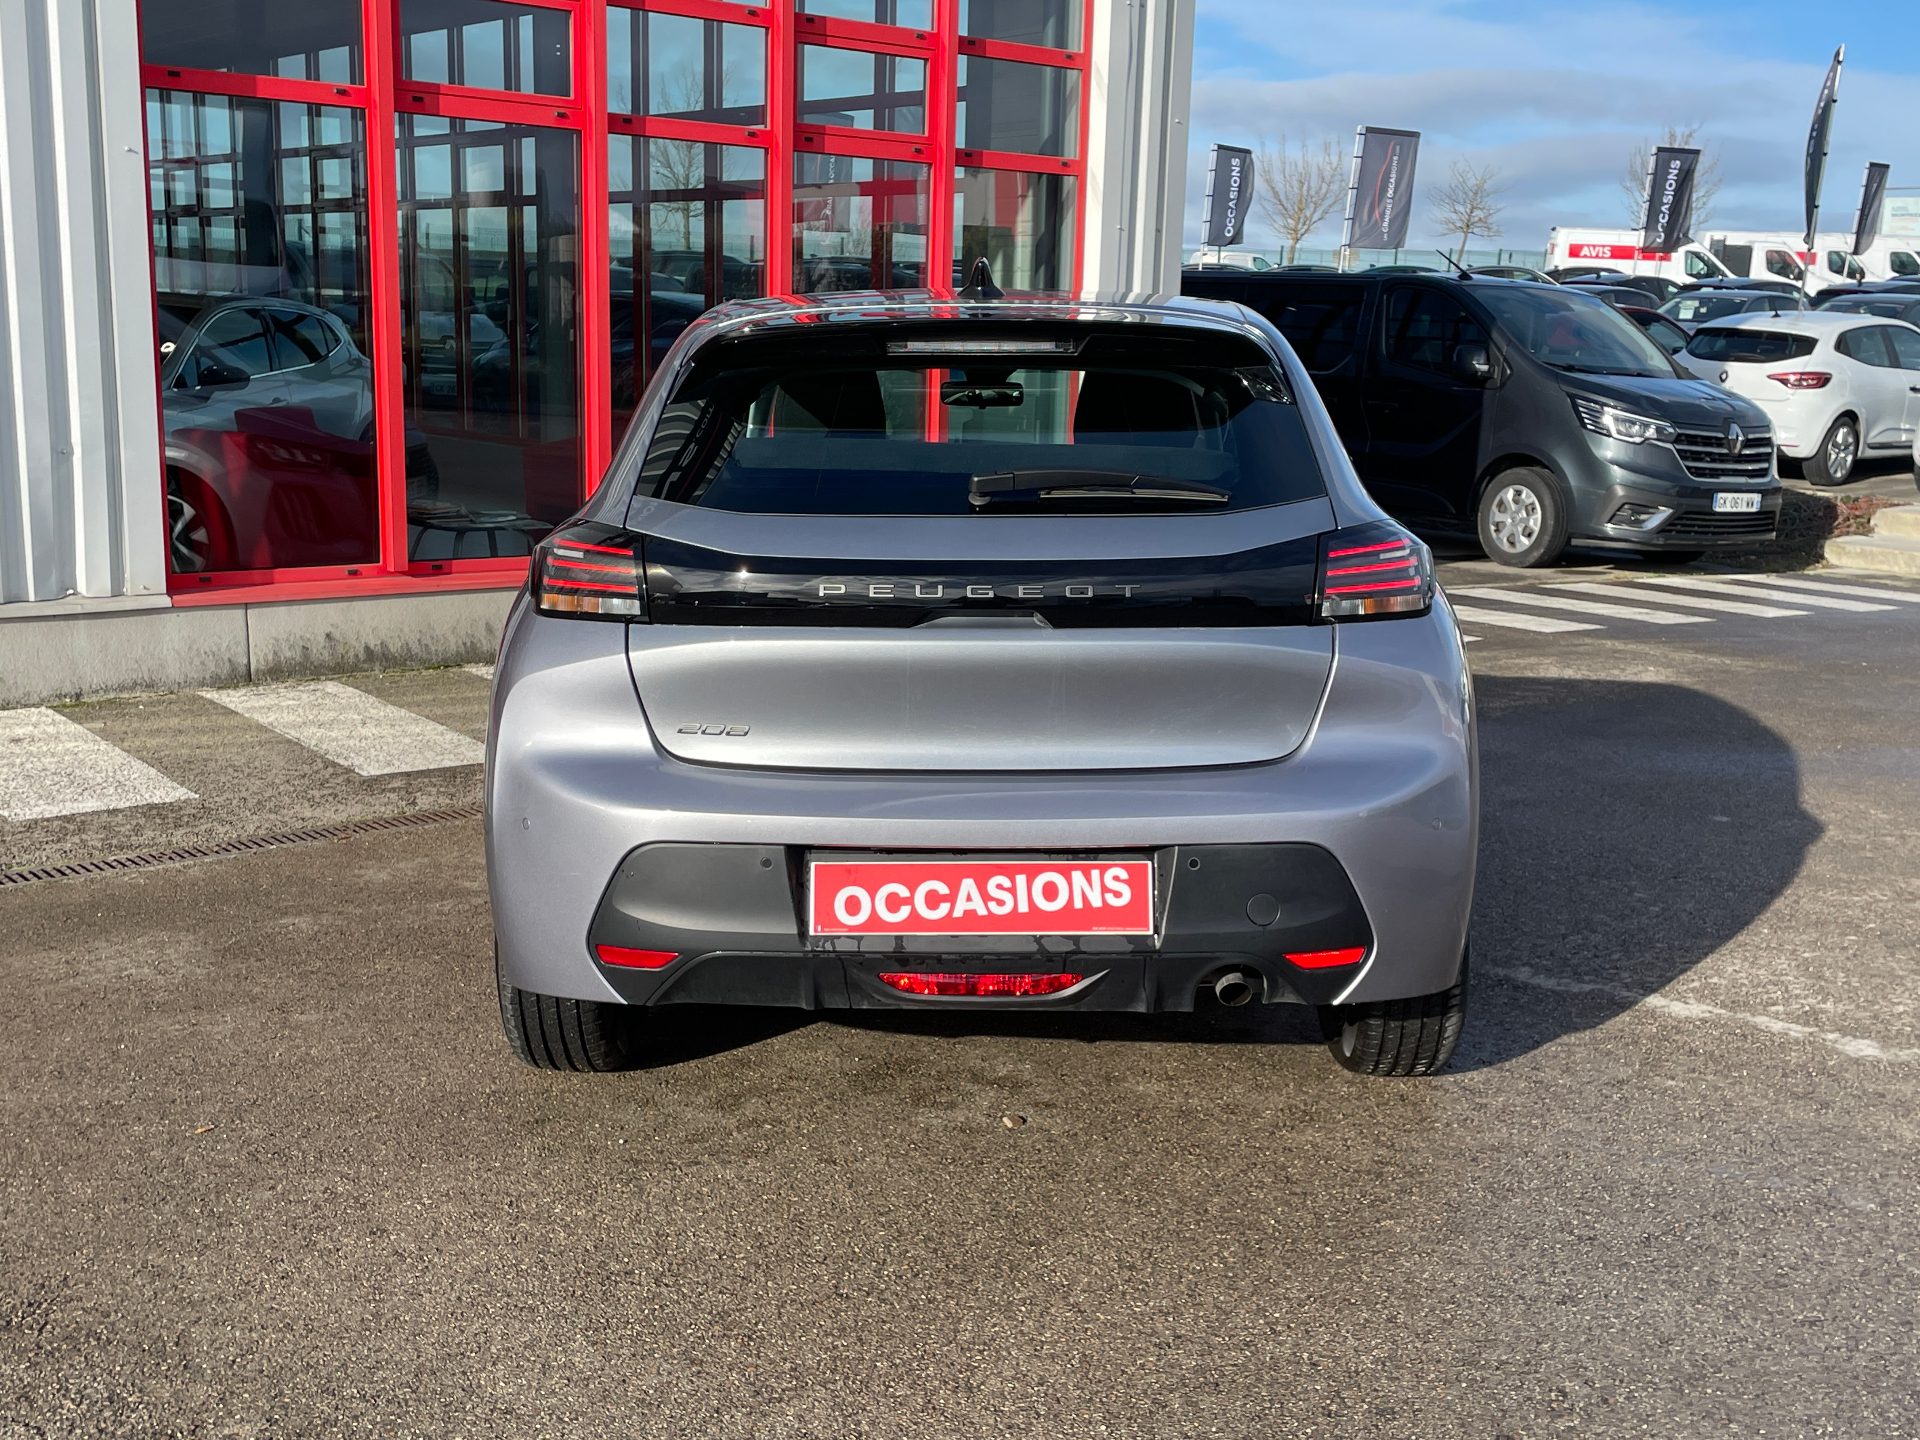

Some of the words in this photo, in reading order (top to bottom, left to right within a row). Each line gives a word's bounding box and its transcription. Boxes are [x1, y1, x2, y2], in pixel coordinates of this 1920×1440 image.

[1224, 157, 1241, 237] OCCASIONS
[1382, 198, 1393, 233] GRANDES
[1580, 245, 1612, 258] AVIS
[818, 583, 1142, 599] PEUGEOT
[677, 722, 751, 737] 208
[833, 867, 1132, 926] OCCASIONS
